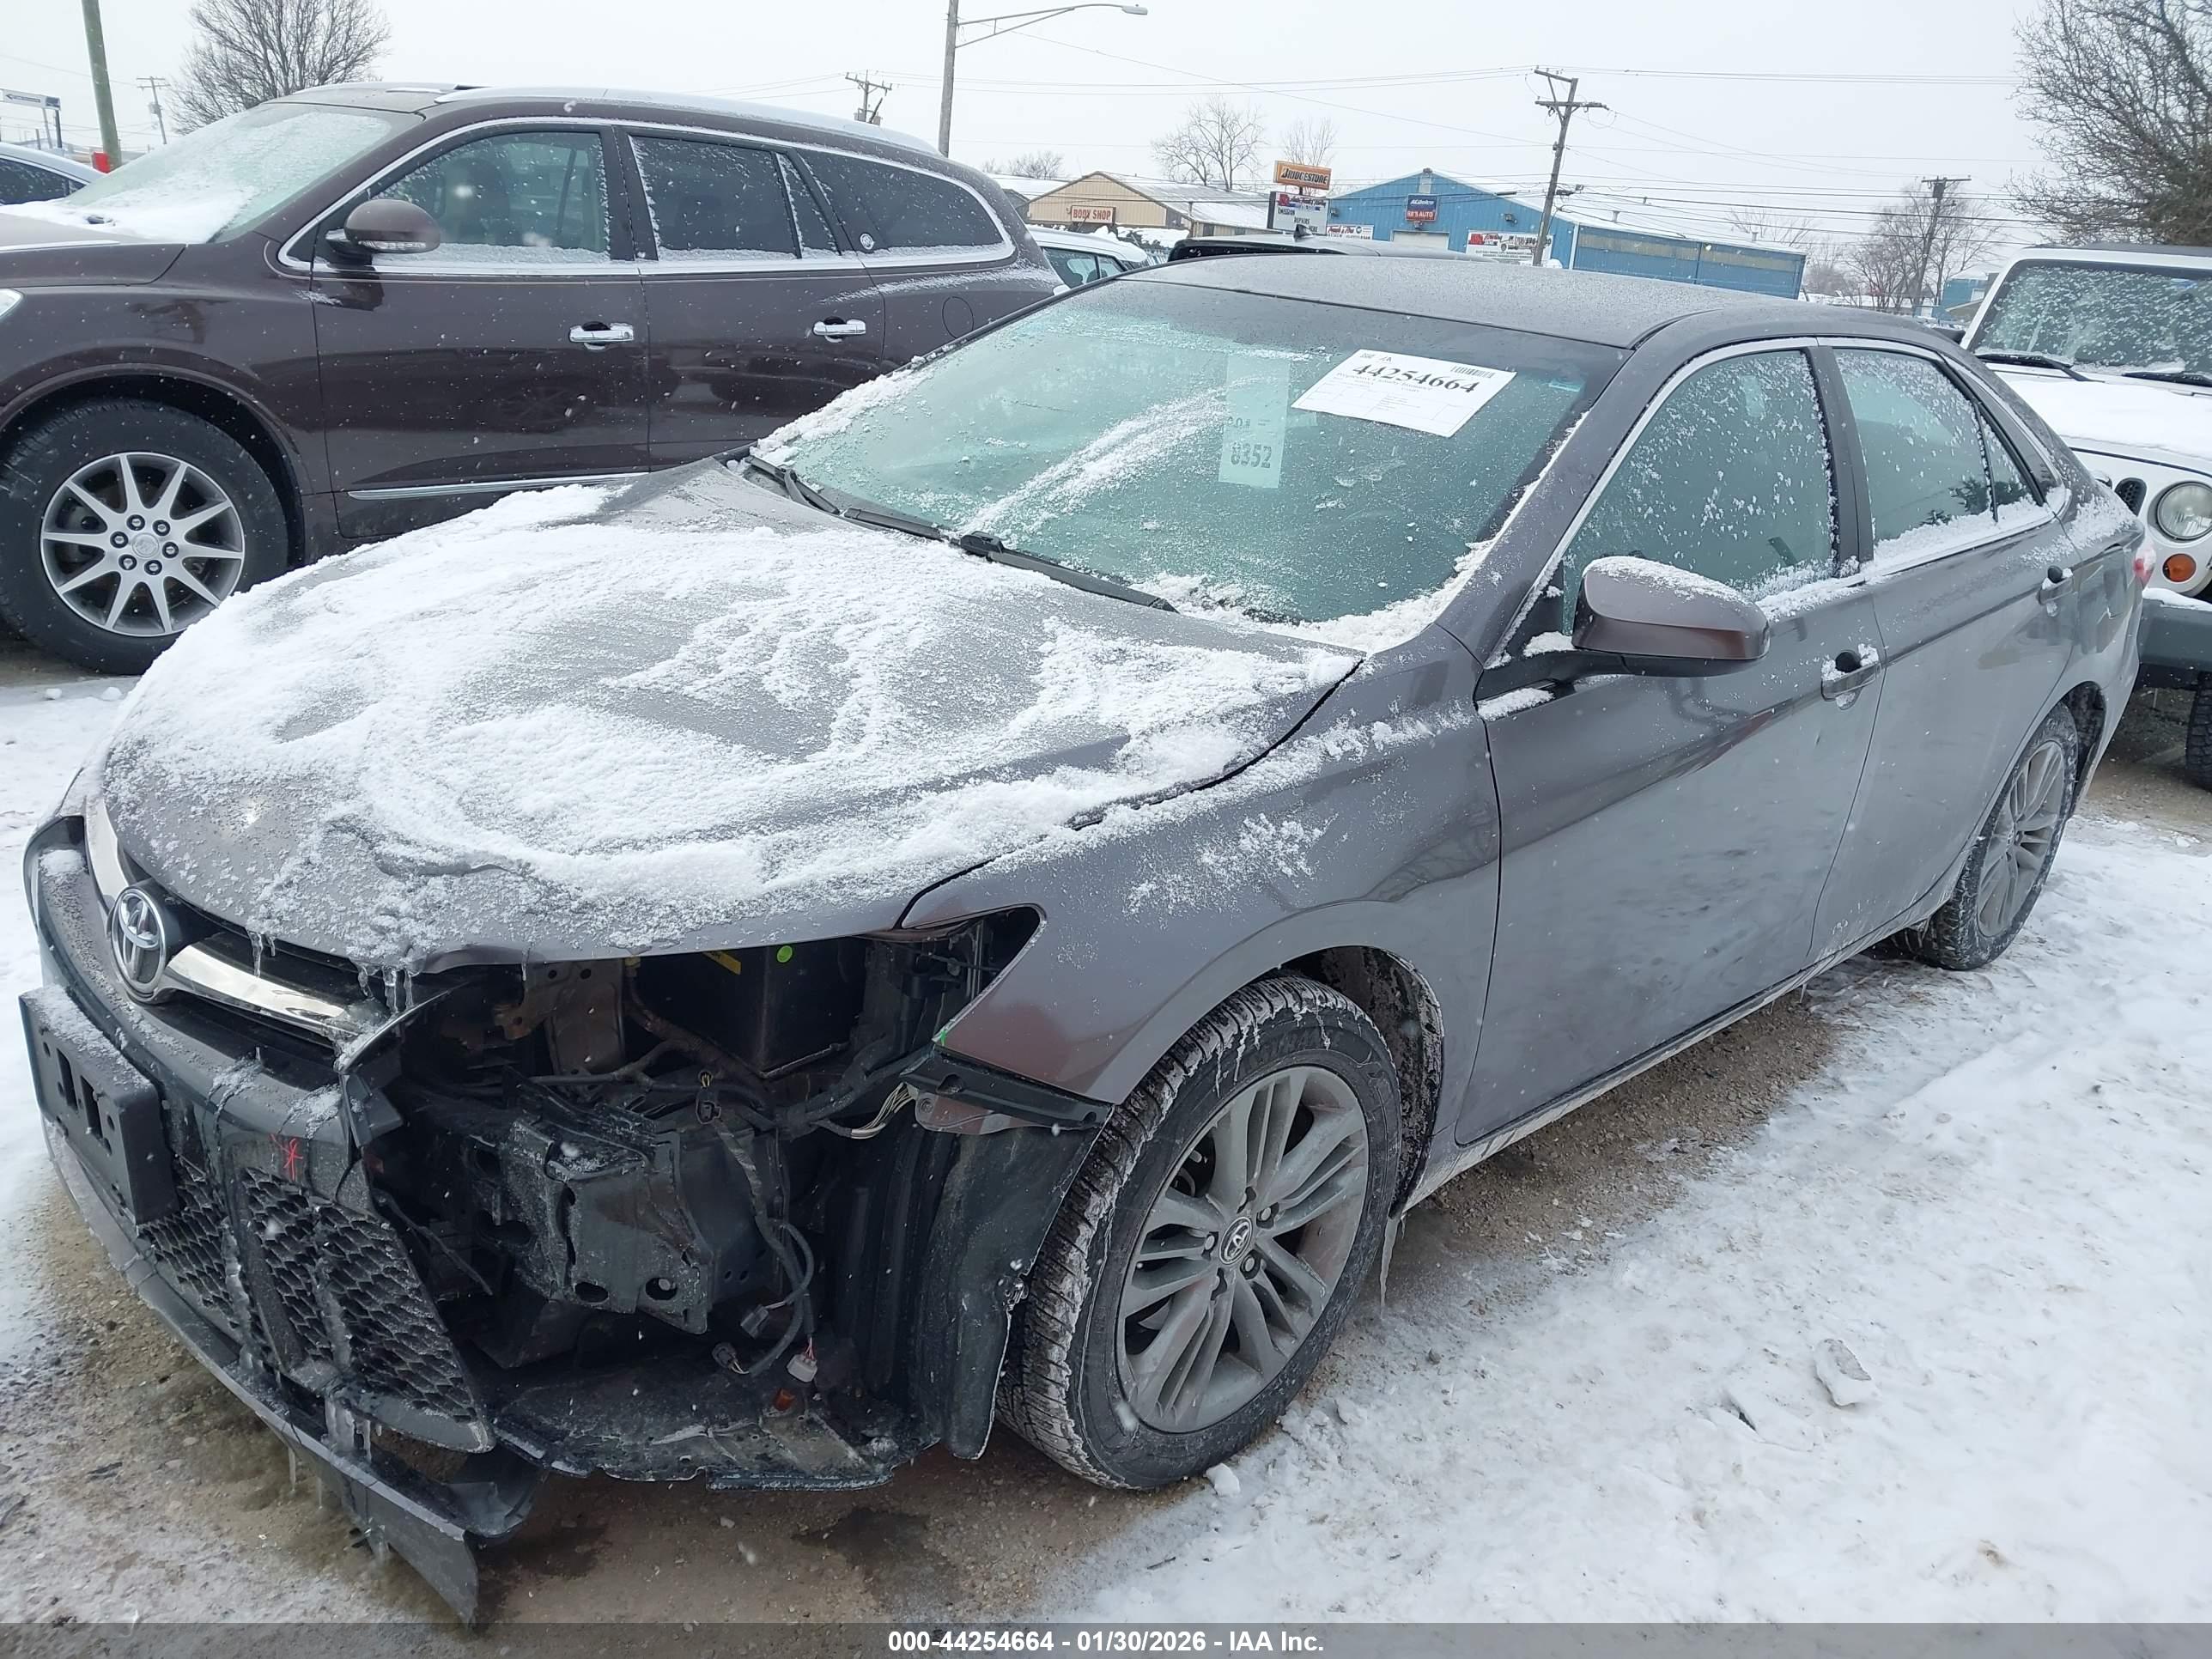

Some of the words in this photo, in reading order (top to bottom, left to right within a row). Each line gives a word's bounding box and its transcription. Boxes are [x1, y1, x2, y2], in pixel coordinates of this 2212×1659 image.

[1281, 167, 1328, 185] BRIDGESTONE
[1073, 209, 1091, 219] BODY
[1092, 210, 1111, 221] SHOP
[1352, 363, 1480, 393] 44254664
